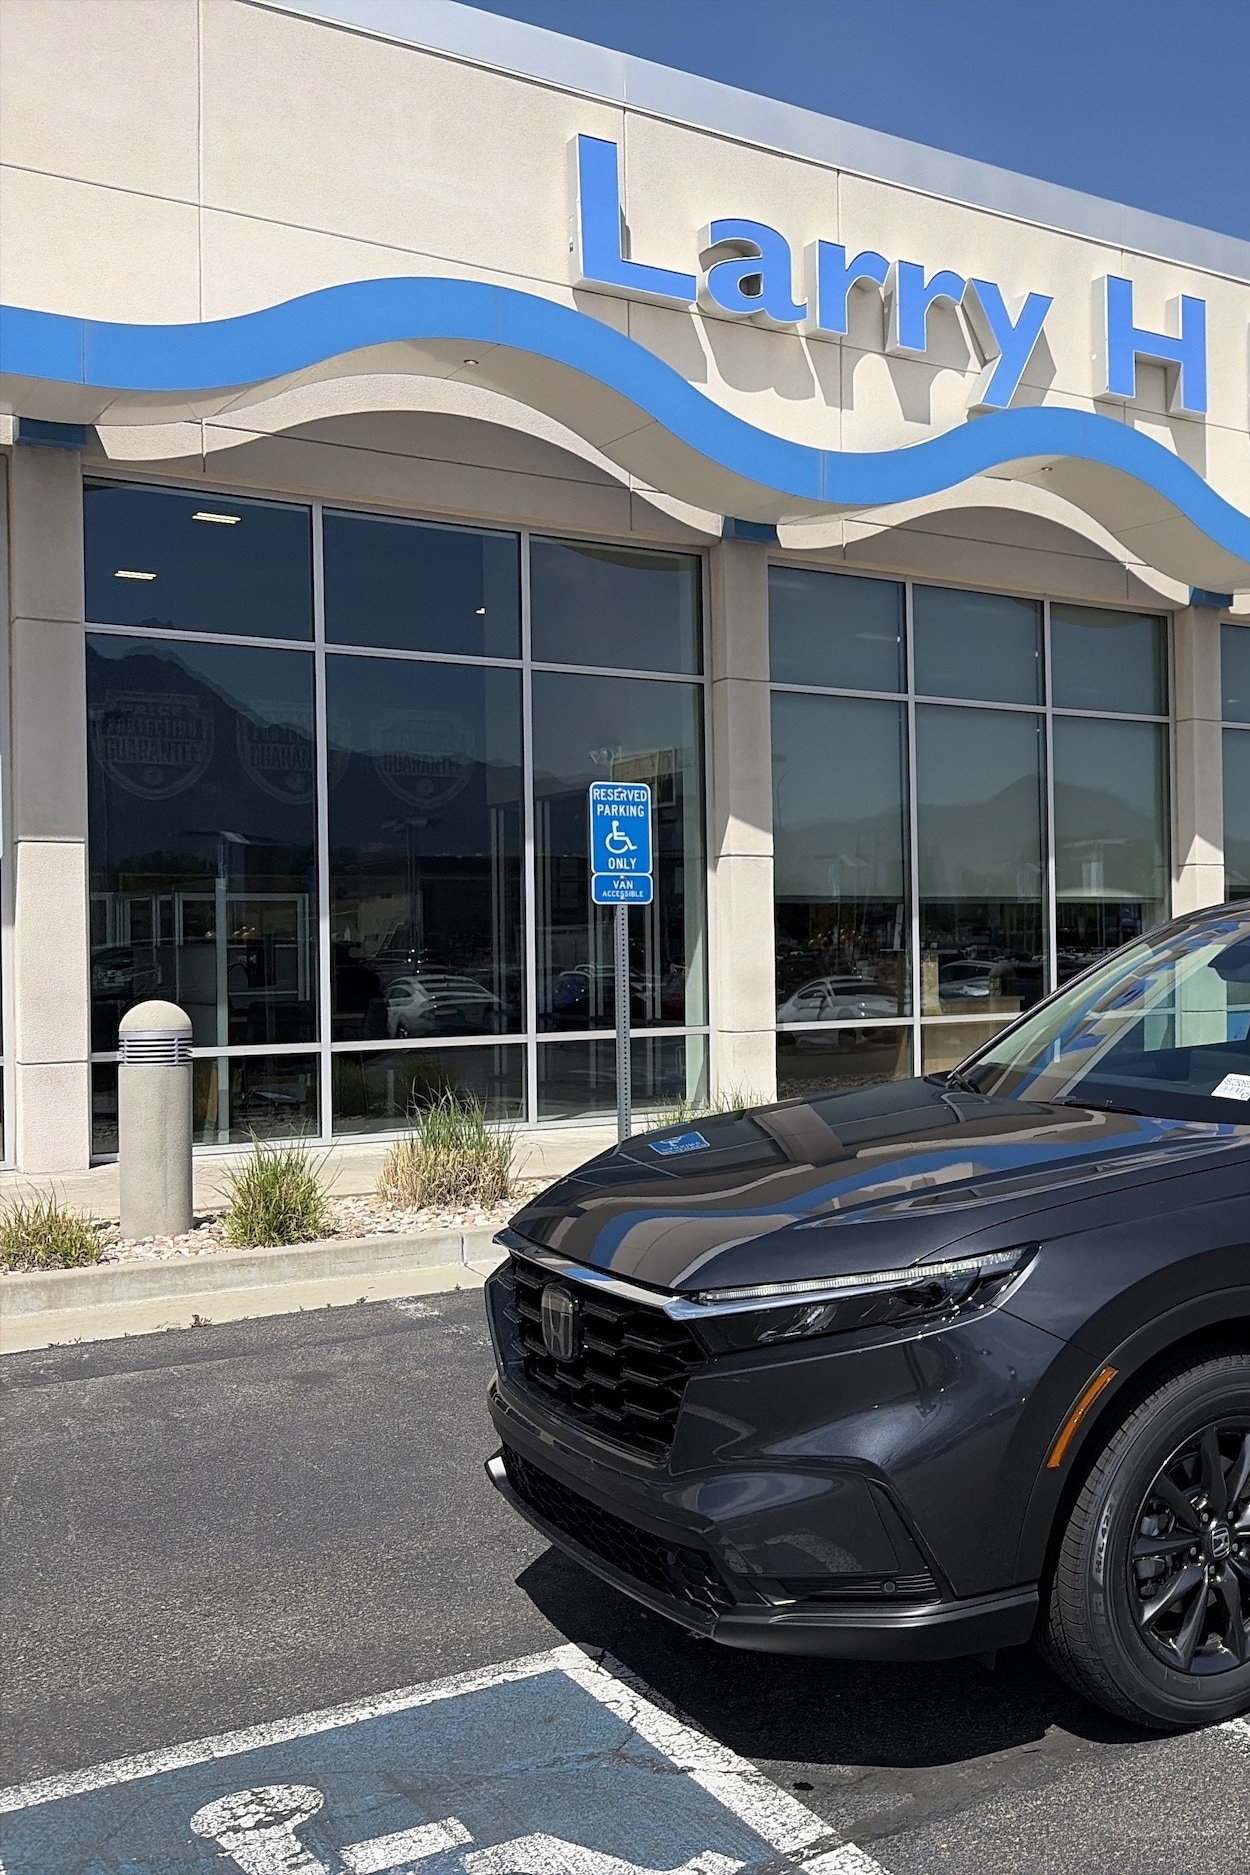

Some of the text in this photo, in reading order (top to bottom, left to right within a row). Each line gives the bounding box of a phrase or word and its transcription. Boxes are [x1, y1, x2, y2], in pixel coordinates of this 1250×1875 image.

[570, 133, 1054, 409] Larry
[1098, 274, 1207, 415] H
[593, 788, 647, 802] RESERVED
[597, 804, 645, 817] PARKING
[608, 857, 637, 869] ONLY
[613, 880, 634, 890] VAN
[602, 890, 644, 898] ACCESSIBLE
